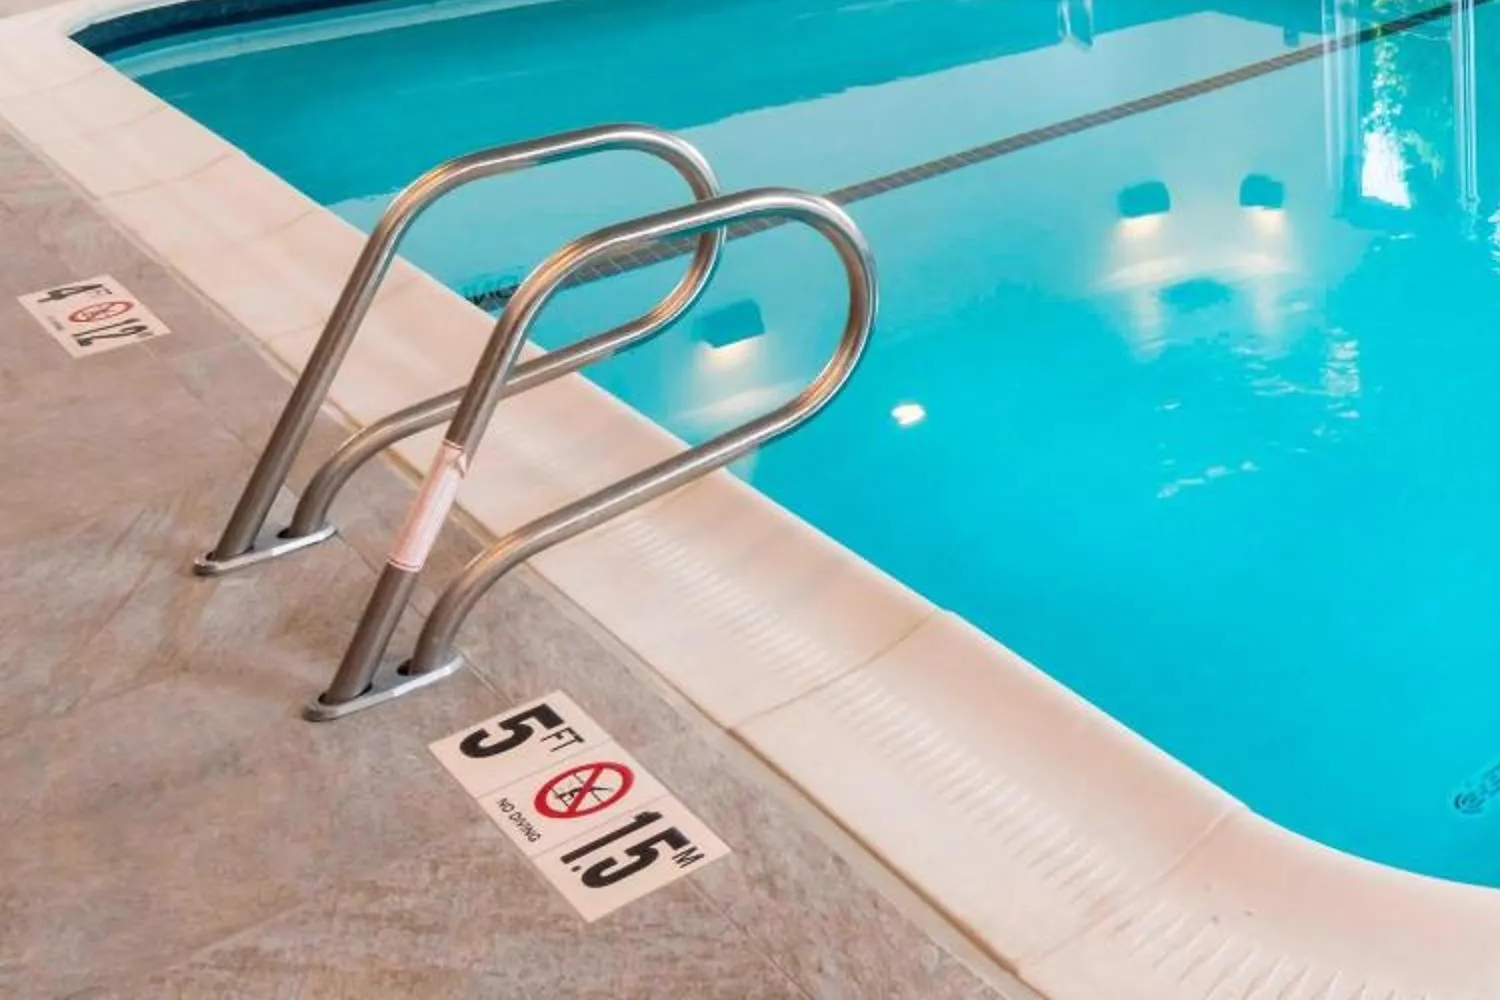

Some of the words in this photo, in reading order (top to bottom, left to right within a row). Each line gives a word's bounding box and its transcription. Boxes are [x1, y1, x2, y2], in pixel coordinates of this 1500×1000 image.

[459, 703, 564, 759] 5
[540, 726, 585, 752] FT
[496, 797, 515, 813] NO
[508, 811, 541, 842] DIVING
[560, 811, 690, 888] 1.5
[672, 846, 705, 868] M
